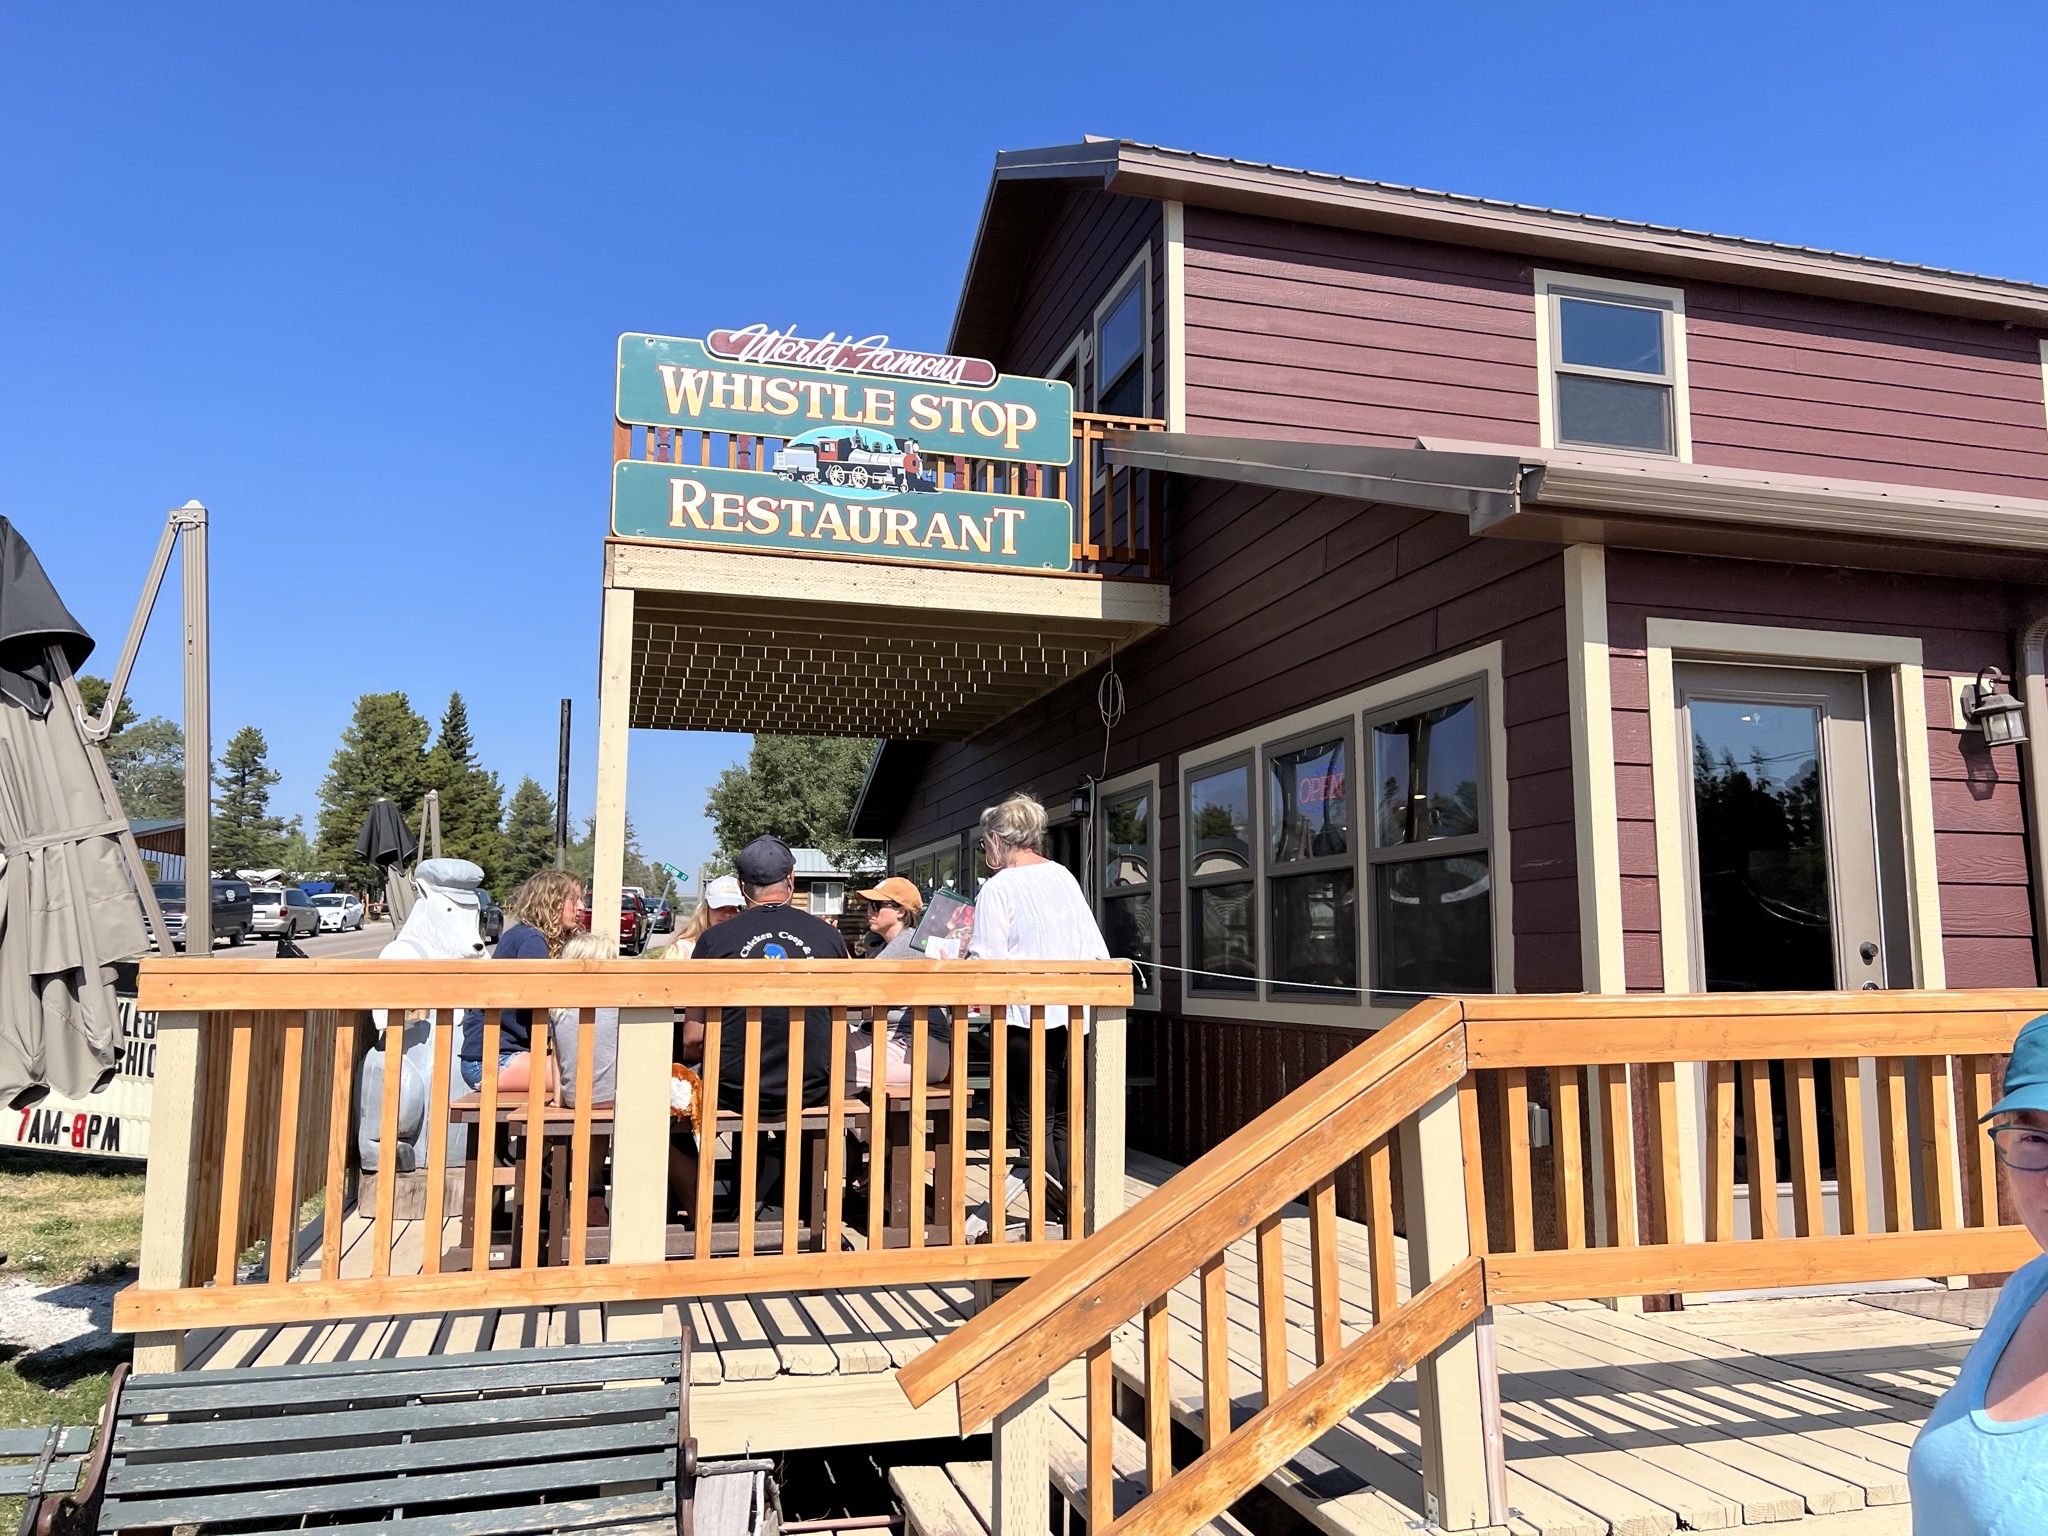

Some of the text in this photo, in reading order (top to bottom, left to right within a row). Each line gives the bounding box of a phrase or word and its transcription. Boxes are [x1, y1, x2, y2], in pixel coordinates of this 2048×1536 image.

[729, 323, 966, 384] World Famous
[658, 365, 1038, 450] WHISTLE STOP
[668, 477, 1026, 556] RESTAURANT
[1299, 773, 1344, 803] OPEN
[740, 931, 811, 958] Chicken Coop &
[118, 1002, 157, 1039] LEB
[17, 1107, 120, 1152] 7AM-8PM
